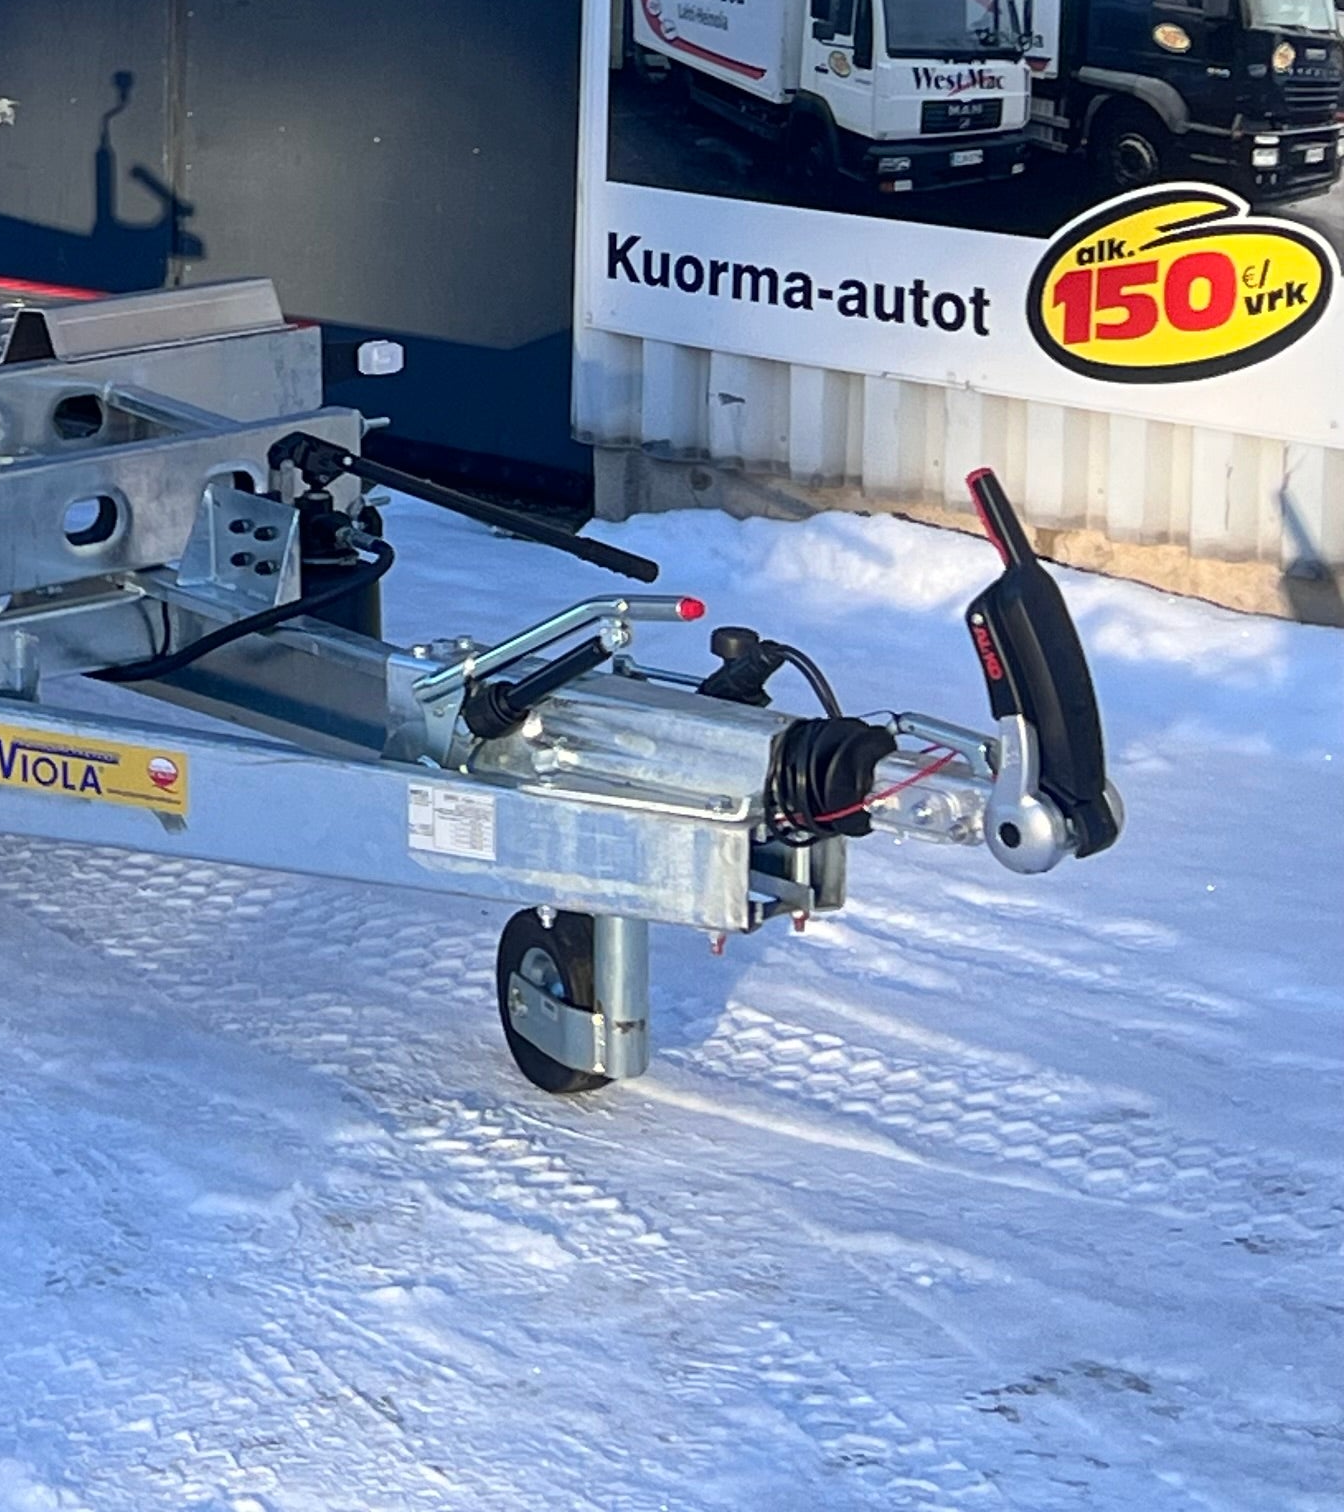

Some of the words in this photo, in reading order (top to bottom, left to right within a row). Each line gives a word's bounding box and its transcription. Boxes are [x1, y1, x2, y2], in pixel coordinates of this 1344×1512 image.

[1076, 238, 1135, 266] alk.
[607, 232, 990, 337] Kuorma-autot
[1052, 251, 1237, 345] 150
[1244, 282, 1308, 316] vrk
